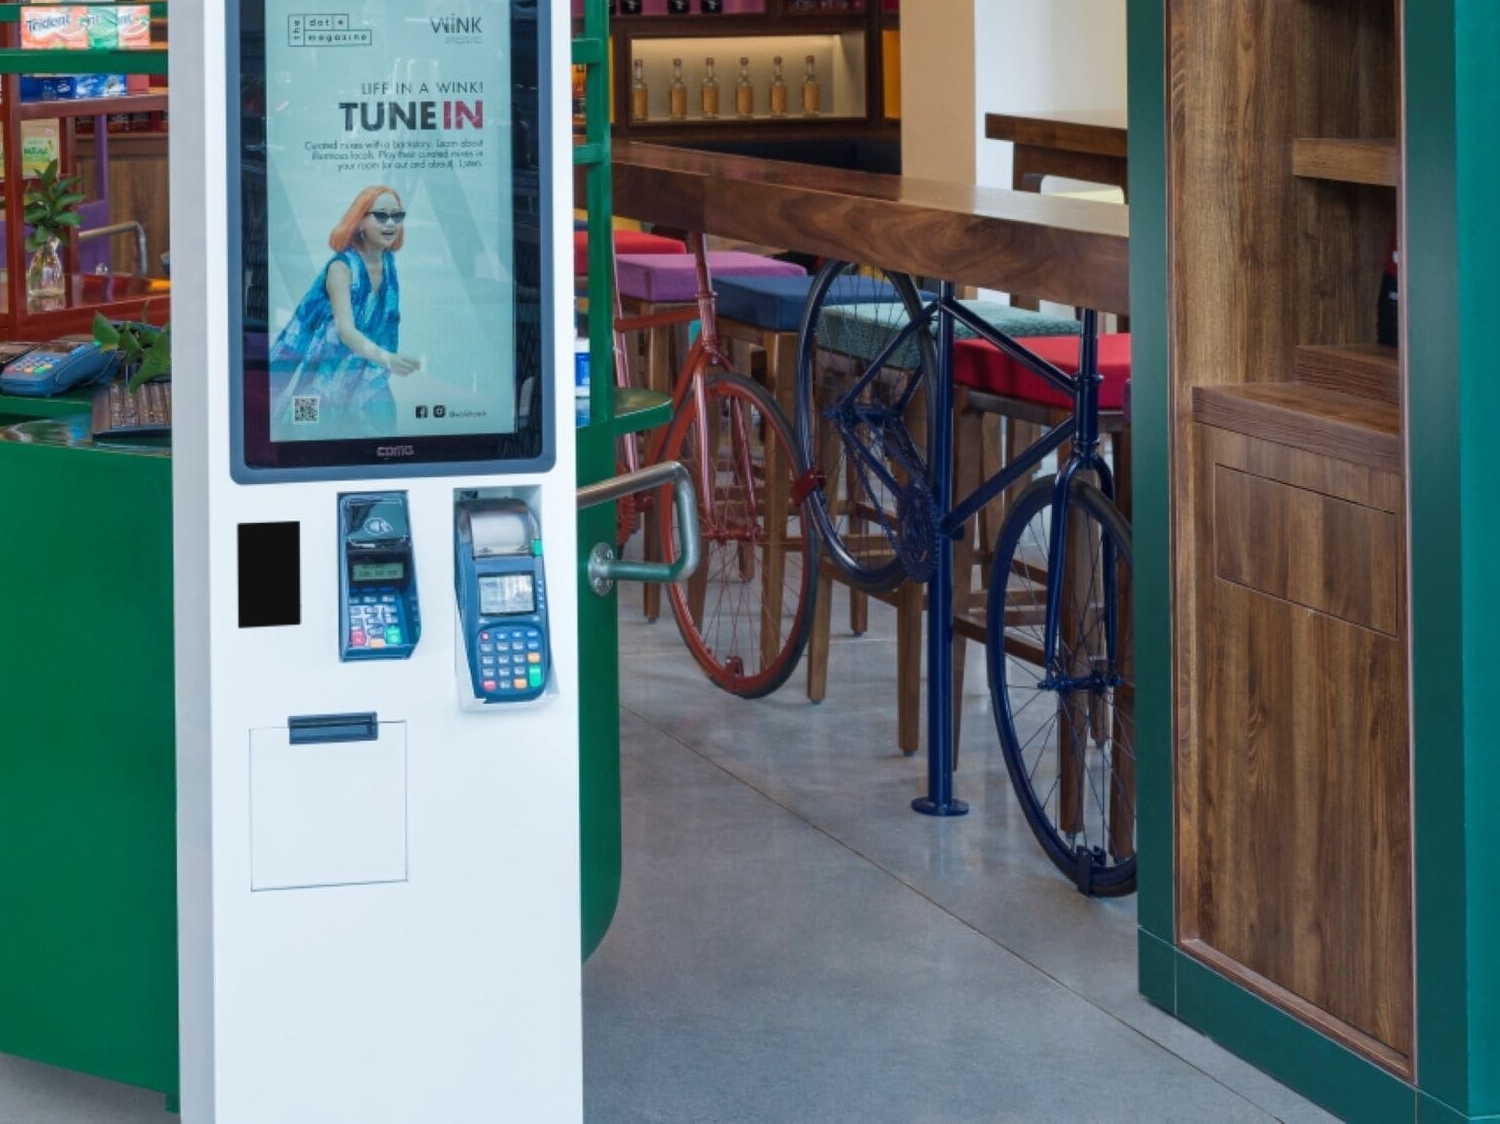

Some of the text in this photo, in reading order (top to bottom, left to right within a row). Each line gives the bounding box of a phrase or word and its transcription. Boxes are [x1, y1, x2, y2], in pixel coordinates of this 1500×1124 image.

[27, 14, 70, 32] Trident
[309, 19, 330, 27] dot
[293, 20, 301, 40] the
[308, 33, 368, 43] magazine
[396, 82, 412, 95] IN
[419, 81, 429, 93] A
[436, 81, 484, 94] WINK!
[338, 100, 484, 132] TUNE IN
[436, 139, 458, 148] Learn
[460, 138, 483, 148] about
[379, 150, 396, 161] Play
[419, 148, 448, 158] curated
[338, 163, 355, 172] your
[357, 162, 380, 170] room
[394, 161, 408, 169] out
[410, 161, 425, 169] and
